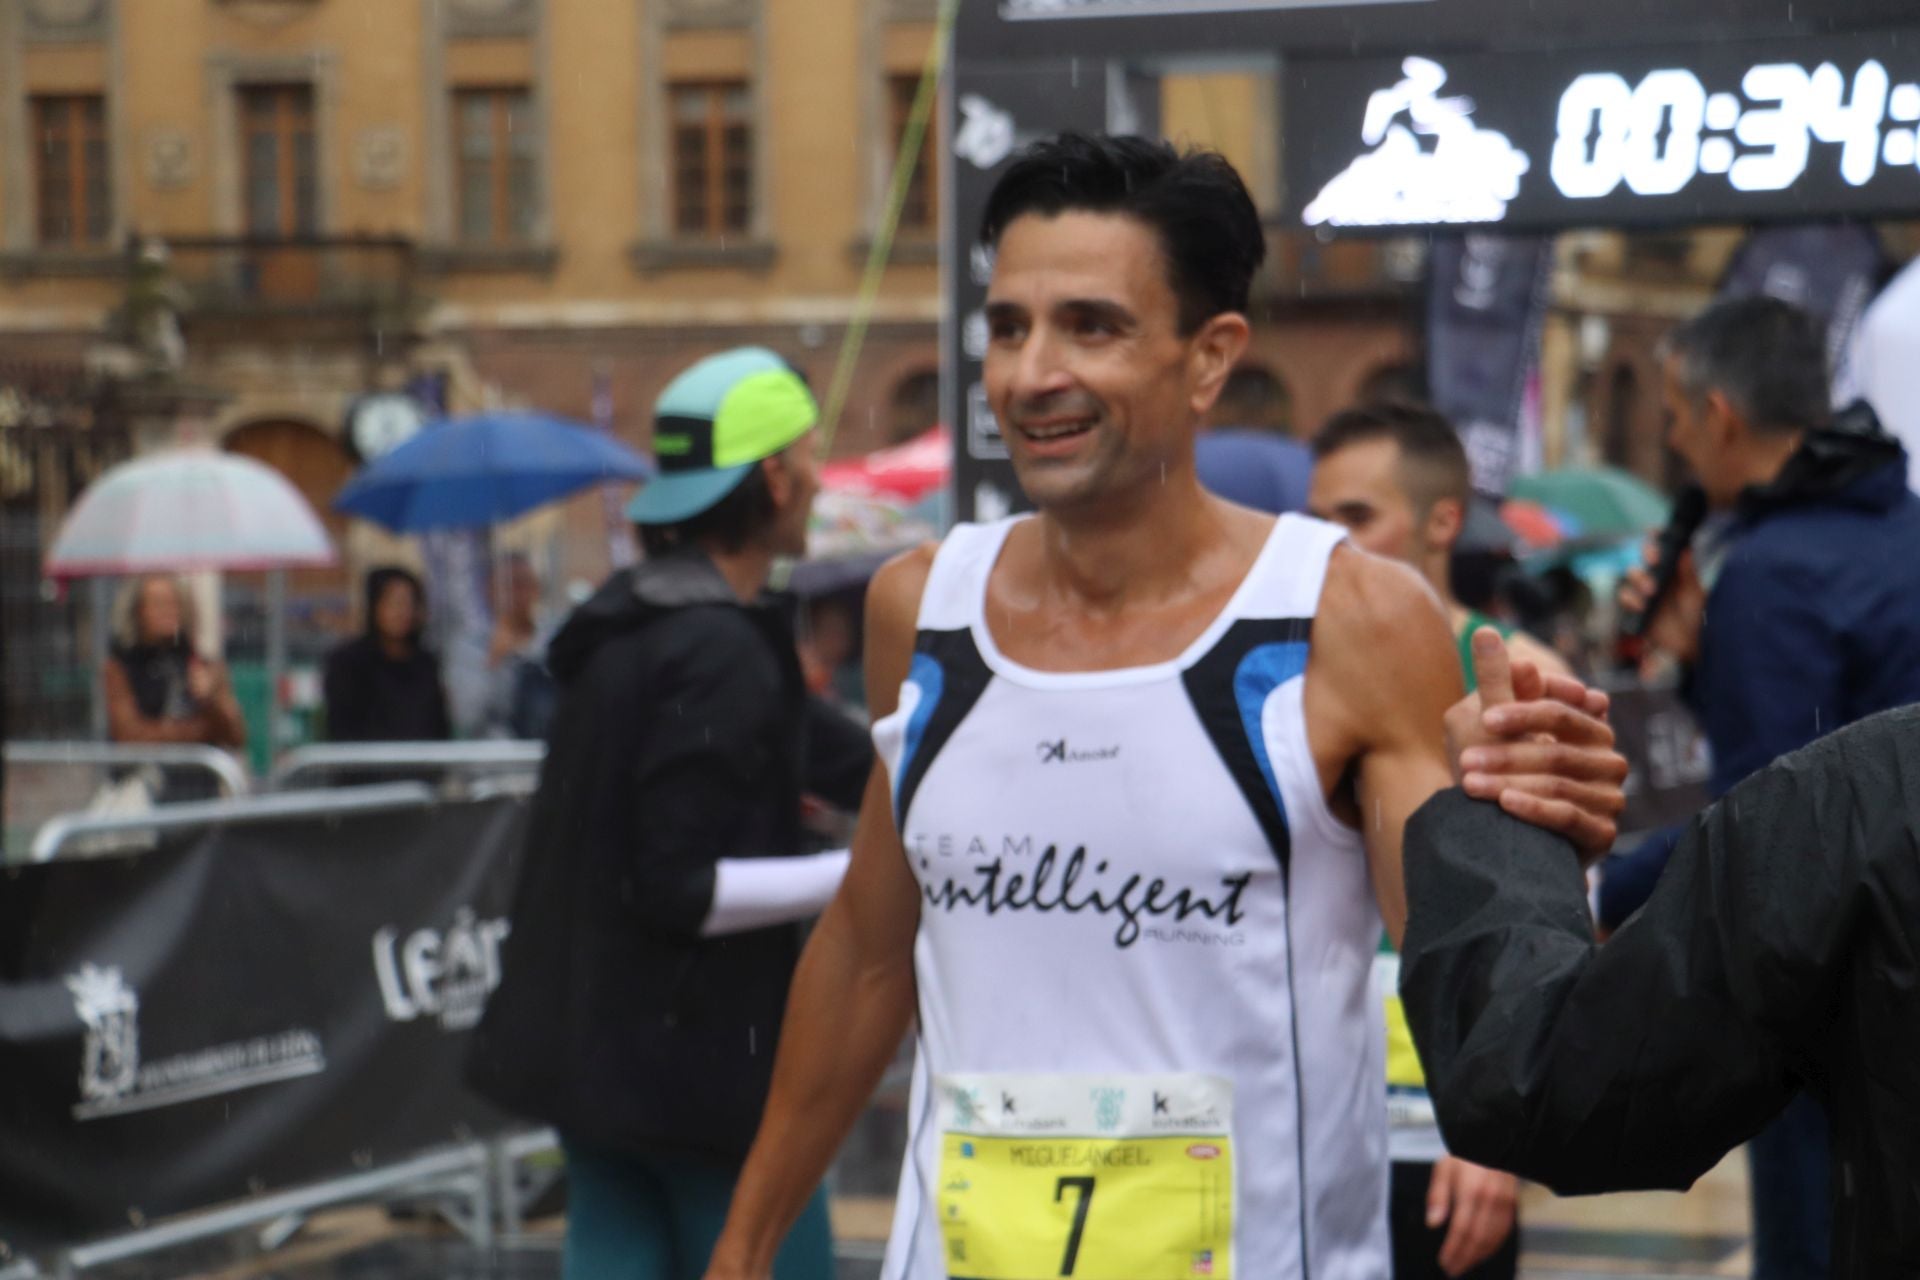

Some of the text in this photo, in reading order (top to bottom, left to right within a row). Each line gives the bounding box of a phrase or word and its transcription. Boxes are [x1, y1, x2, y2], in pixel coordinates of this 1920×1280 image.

[1551, 60, 1920, 198] 00:34:
[913, 833, 1034, 858] TEAM
[918, 844, 1253, 949] intelligent
[1143, 928, 1246, 947] RUNNING
[1053, 1176, 1096, 1277] 7
